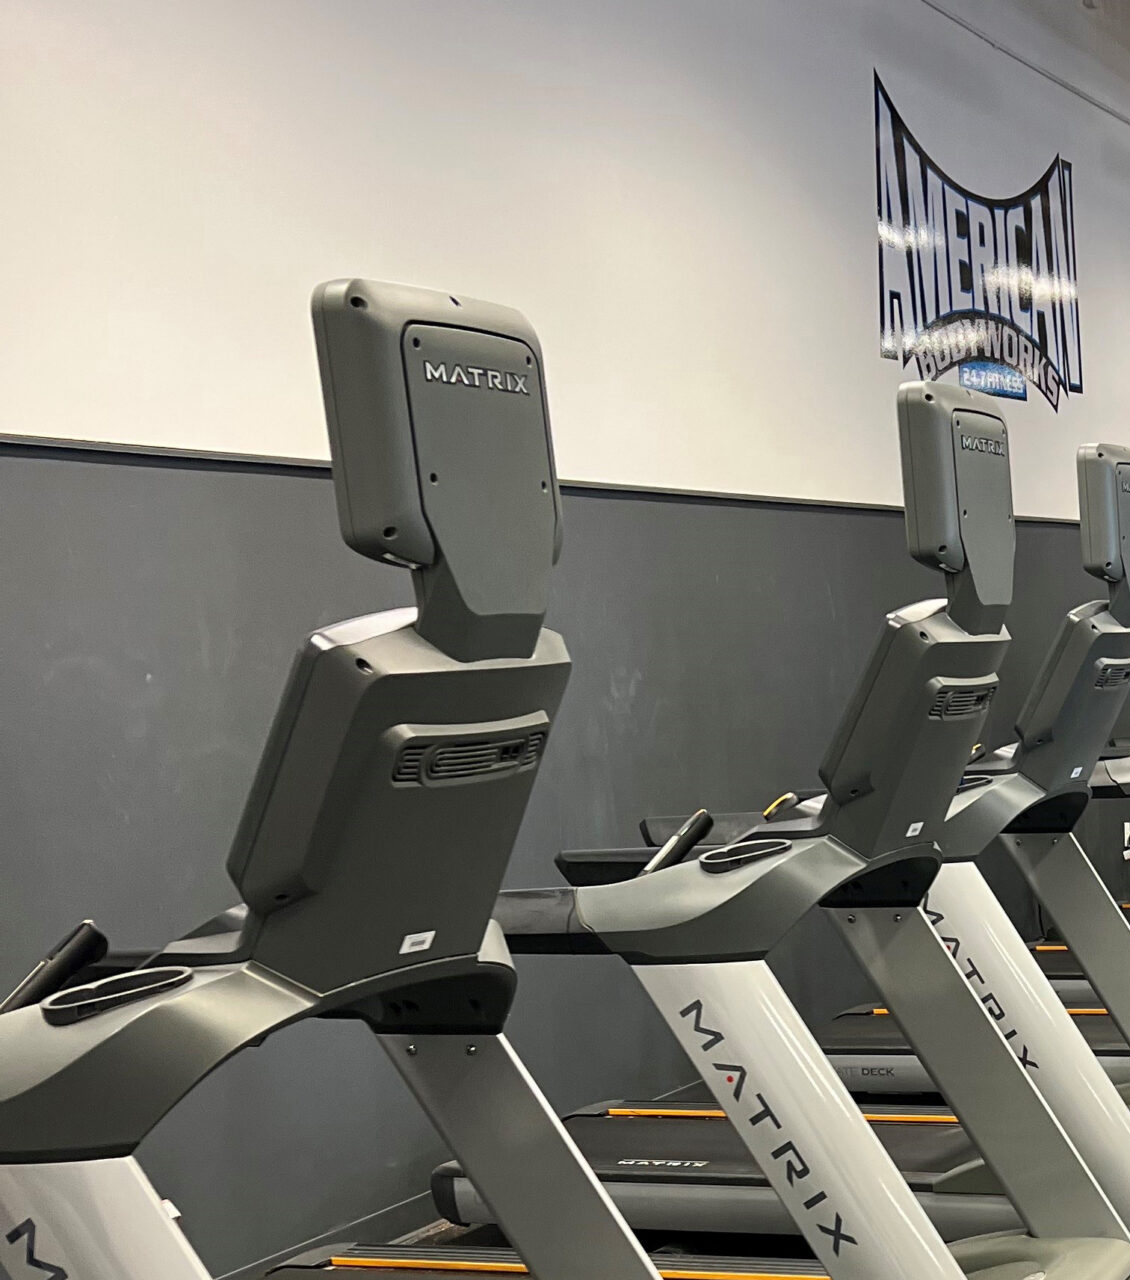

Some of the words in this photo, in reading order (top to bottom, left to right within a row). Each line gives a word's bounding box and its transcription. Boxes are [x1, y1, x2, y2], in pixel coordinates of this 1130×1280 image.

[874, 68, 1083, 396] AMERICAN
[424, 360, 530, 395] MATRIX
[919, 317, 1061, 412] BODYWORKS
[987, 370, 1025, 394] FITNESS
[961, 435, 1006, 457] MATRIX
[922, 890, 1040, 1070] MATRIX
[861, 1067, 895, 1077] DECK
[679, 998, 859, 1258] MATRIX
